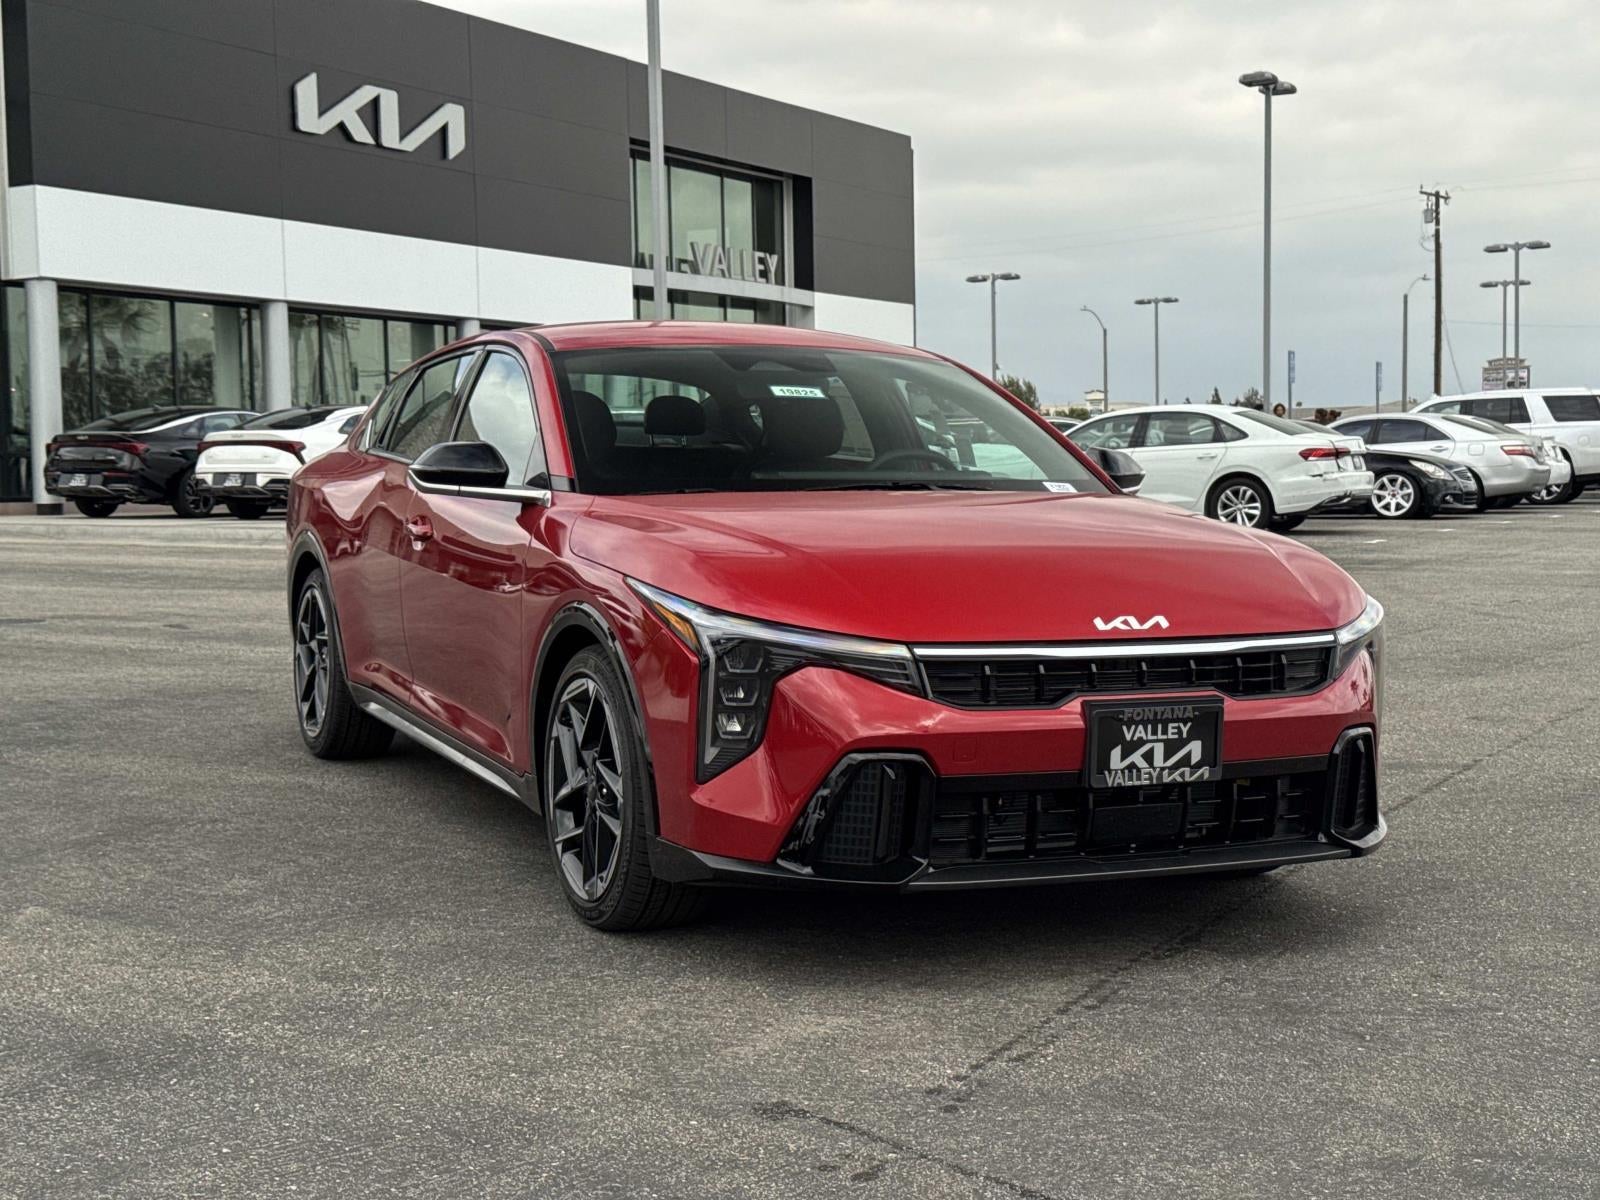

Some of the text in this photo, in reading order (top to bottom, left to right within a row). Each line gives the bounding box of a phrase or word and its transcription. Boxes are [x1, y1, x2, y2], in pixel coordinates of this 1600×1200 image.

[294, 71, 466, 160] KIA
[690, 241, 778, 285] VALLEY
[1092, 615, 1170, 631] KIA
[1122, 722, 1192, 741] VALLEY
[1110, 740, 1202, 770] KIA
[1104, 766, 1210, 787] VALLEY KIA
